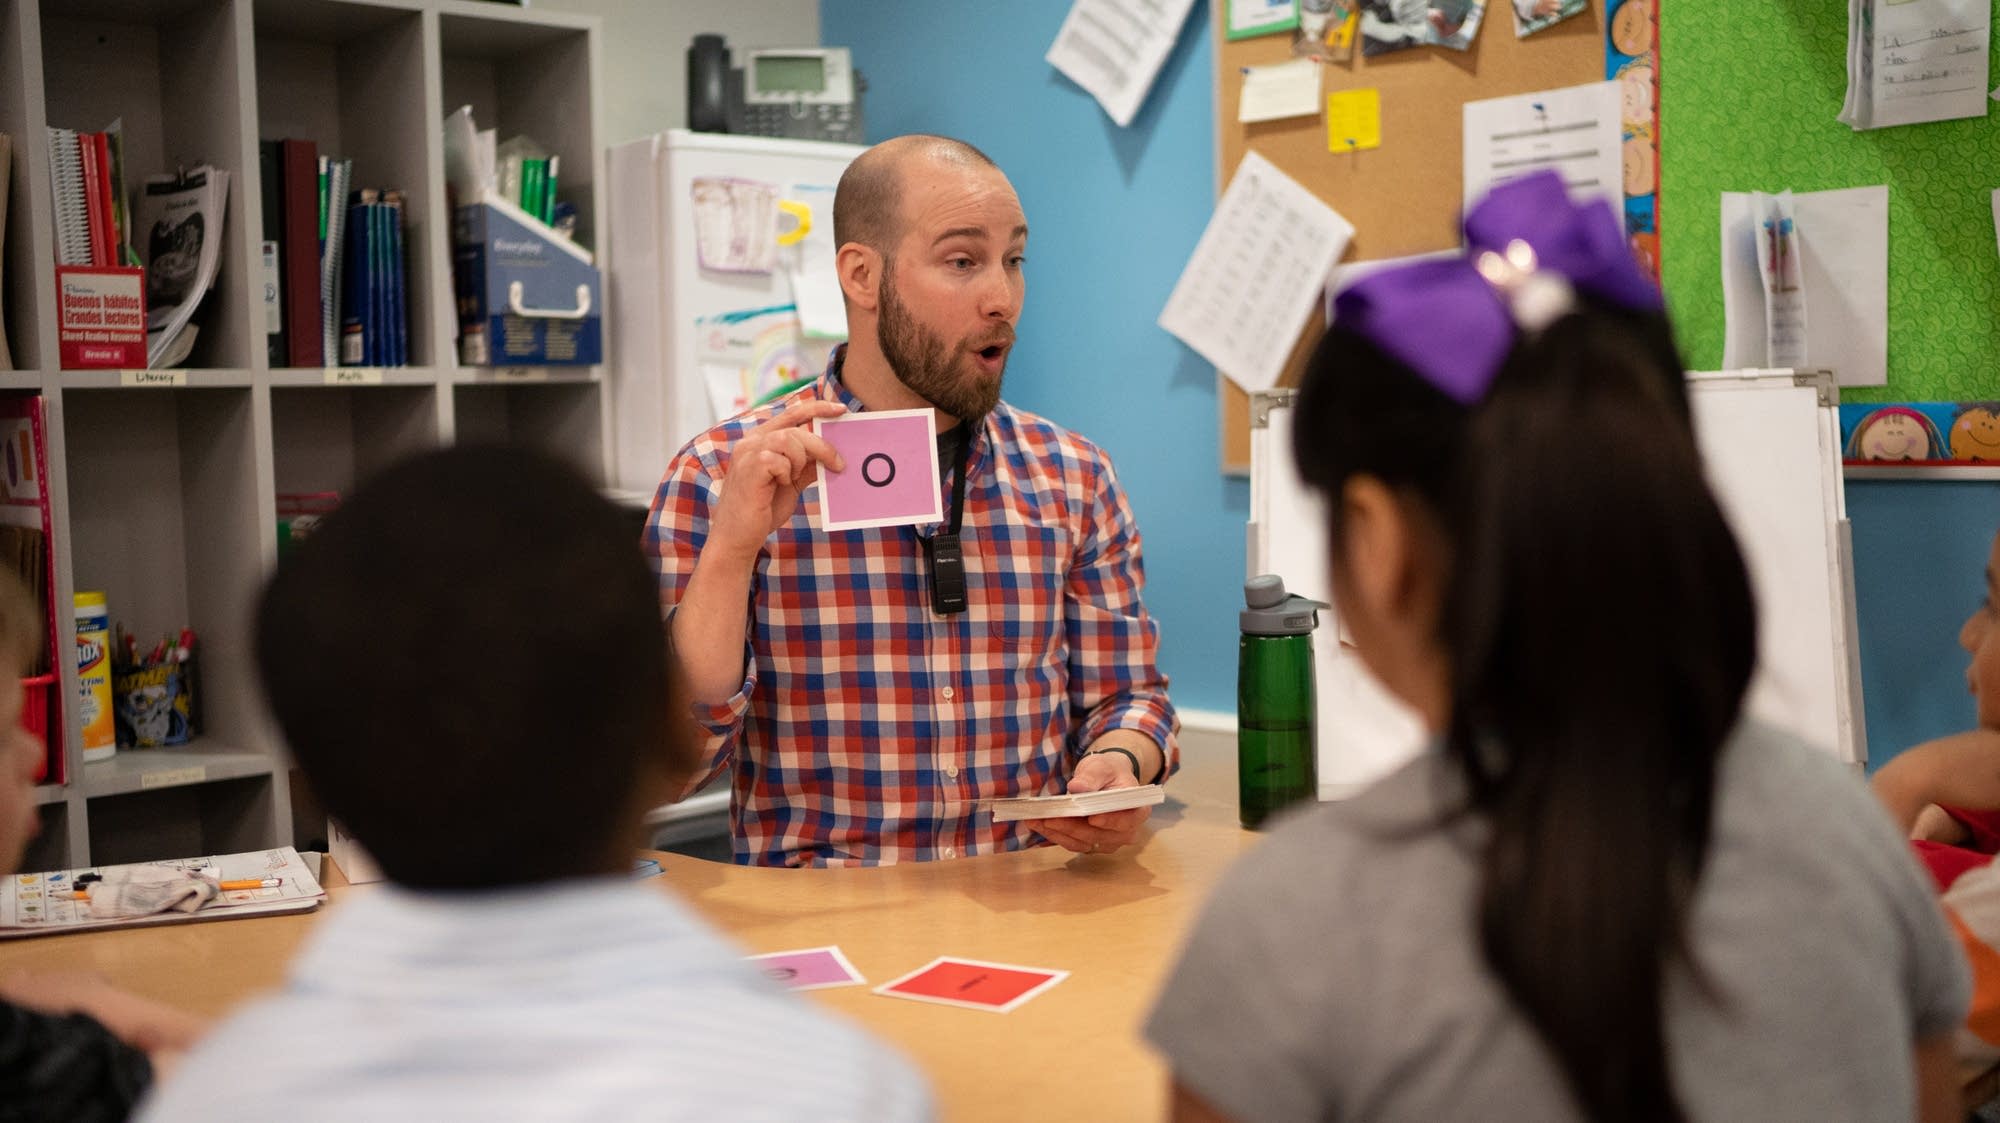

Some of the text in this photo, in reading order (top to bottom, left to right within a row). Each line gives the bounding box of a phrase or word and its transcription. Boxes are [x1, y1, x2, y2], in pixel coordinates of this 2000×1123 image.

[64, 294, 139, 310] Buenos hábitos
[65, 310, 140, 326] Grandes lectores
[62, 330, 142, 344] Shared Reading Resources
[85, 350, 110, 360] Grade
[136, 373, 175, 385] Literacy
[337, 368, 364, 381] Math
